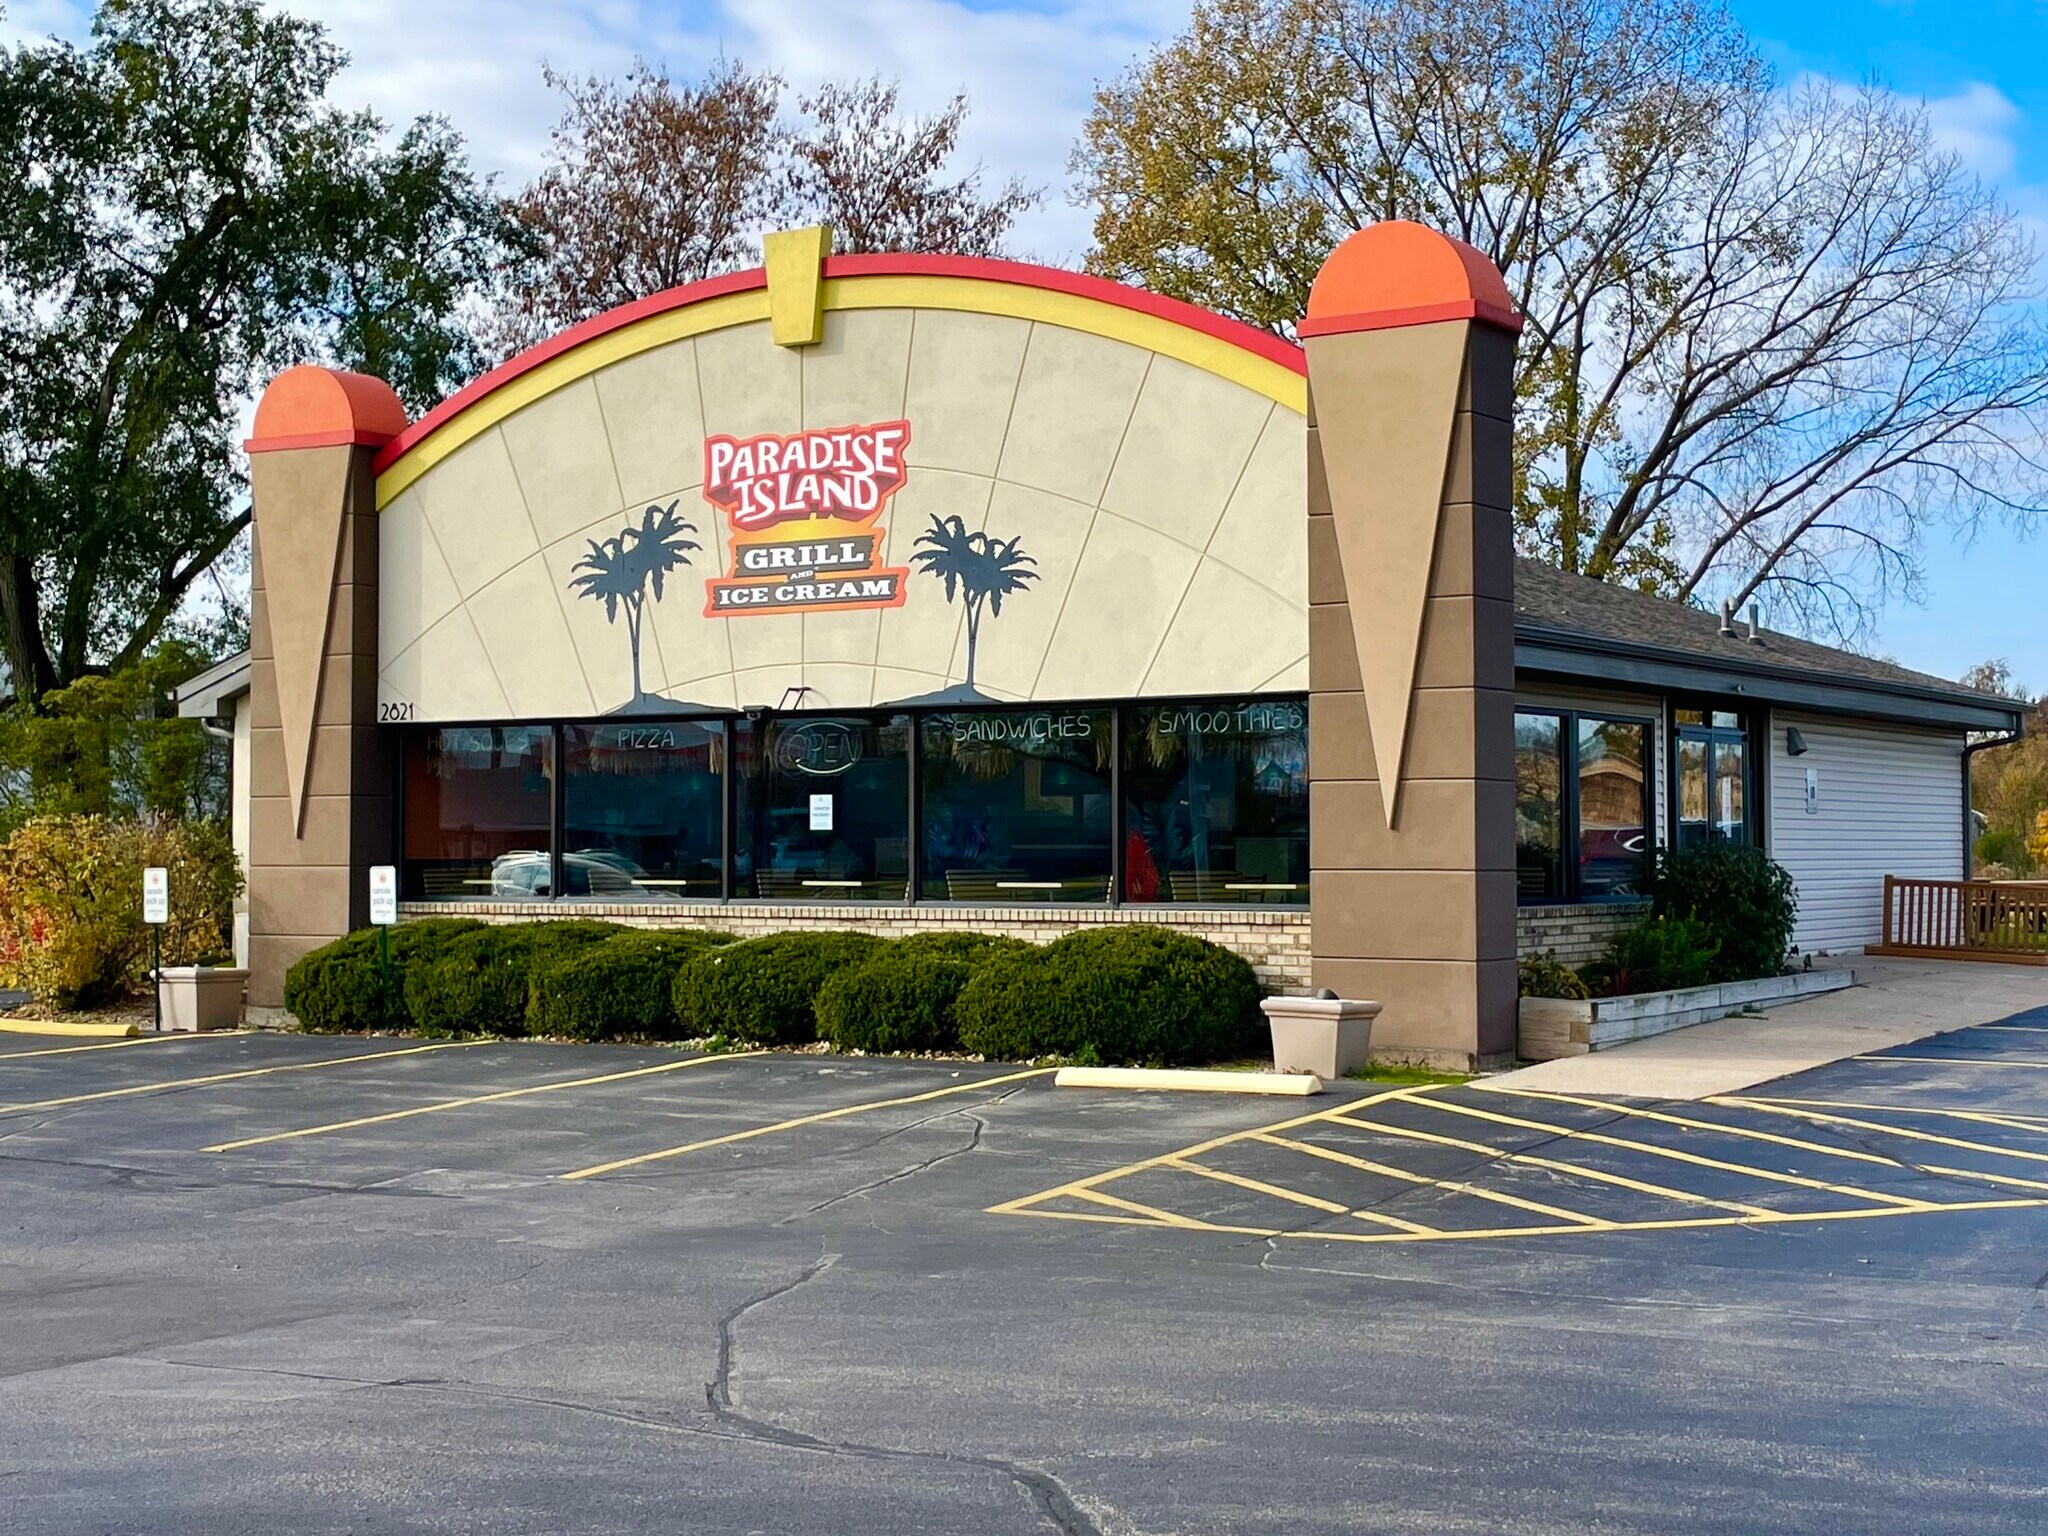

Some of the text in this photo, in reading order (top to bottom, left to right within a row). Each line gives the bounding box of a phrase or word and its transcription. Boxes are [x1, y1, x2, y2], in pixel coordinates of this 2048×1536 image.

[710, 429, 903, 489] PARADISE
[733, 472, 879, 522] ISLAND
[743, 542, 865, 570] GRILL
[790, 569, 814, 580] AND
[719, 579, 891, 605] ICE CREAM
[380, 702, 414, 721] 2821
[1158, 707, 1303, 733] SMOOTHIES
[618, 728, 675, 748] PIZZA
[953, 714, 1092, 742] SANDWICHES
[427, 734, 460, 752] HOT
[787, 733, 860, 763] OPEN
